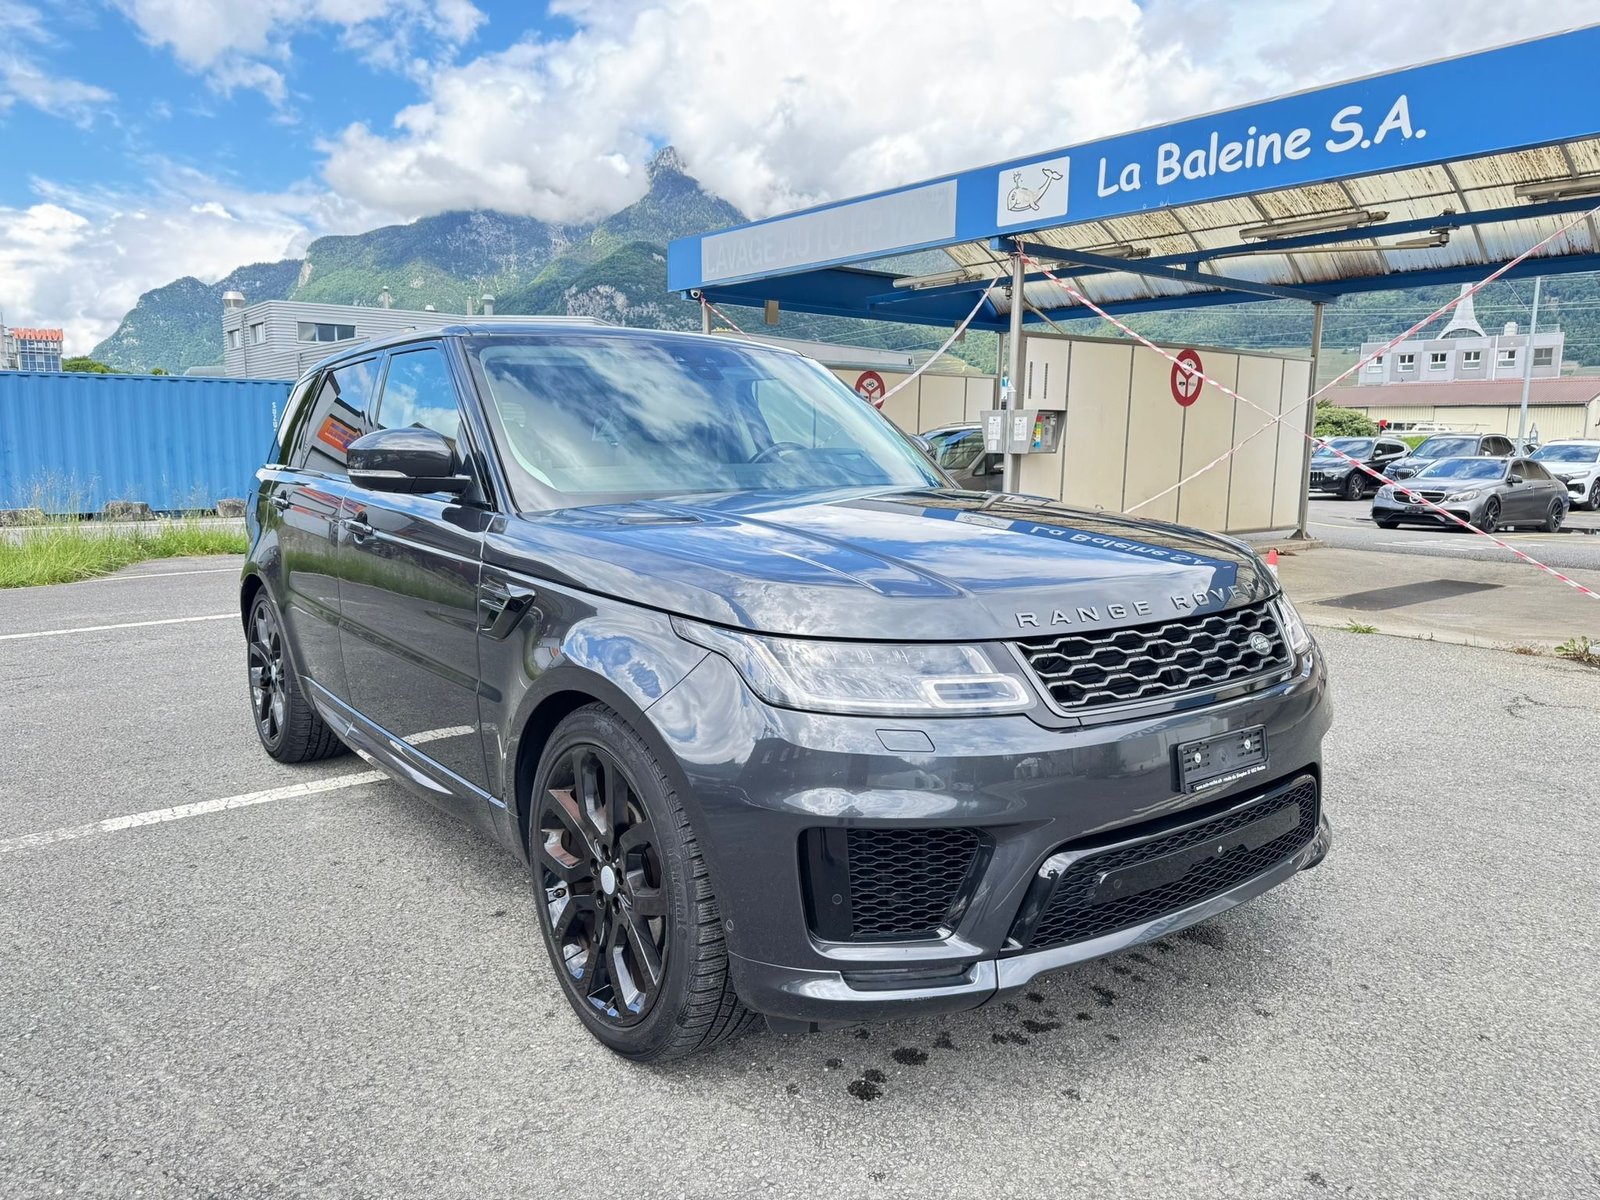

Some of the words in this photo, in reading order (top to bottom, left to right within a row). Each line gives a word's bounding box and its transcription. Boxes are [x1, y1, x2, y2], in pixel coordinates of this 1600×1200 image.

[1097, 157, 1141, 197] La
[1156, 126, 1311, 186] Baleine
[1325, 94, 1427, 153] S.A.
[705, 231, 776, 274] LAVAGE
[1014, 600, 1152, 628] RANGE
[1170, 582, 1258, 610] ROVER
